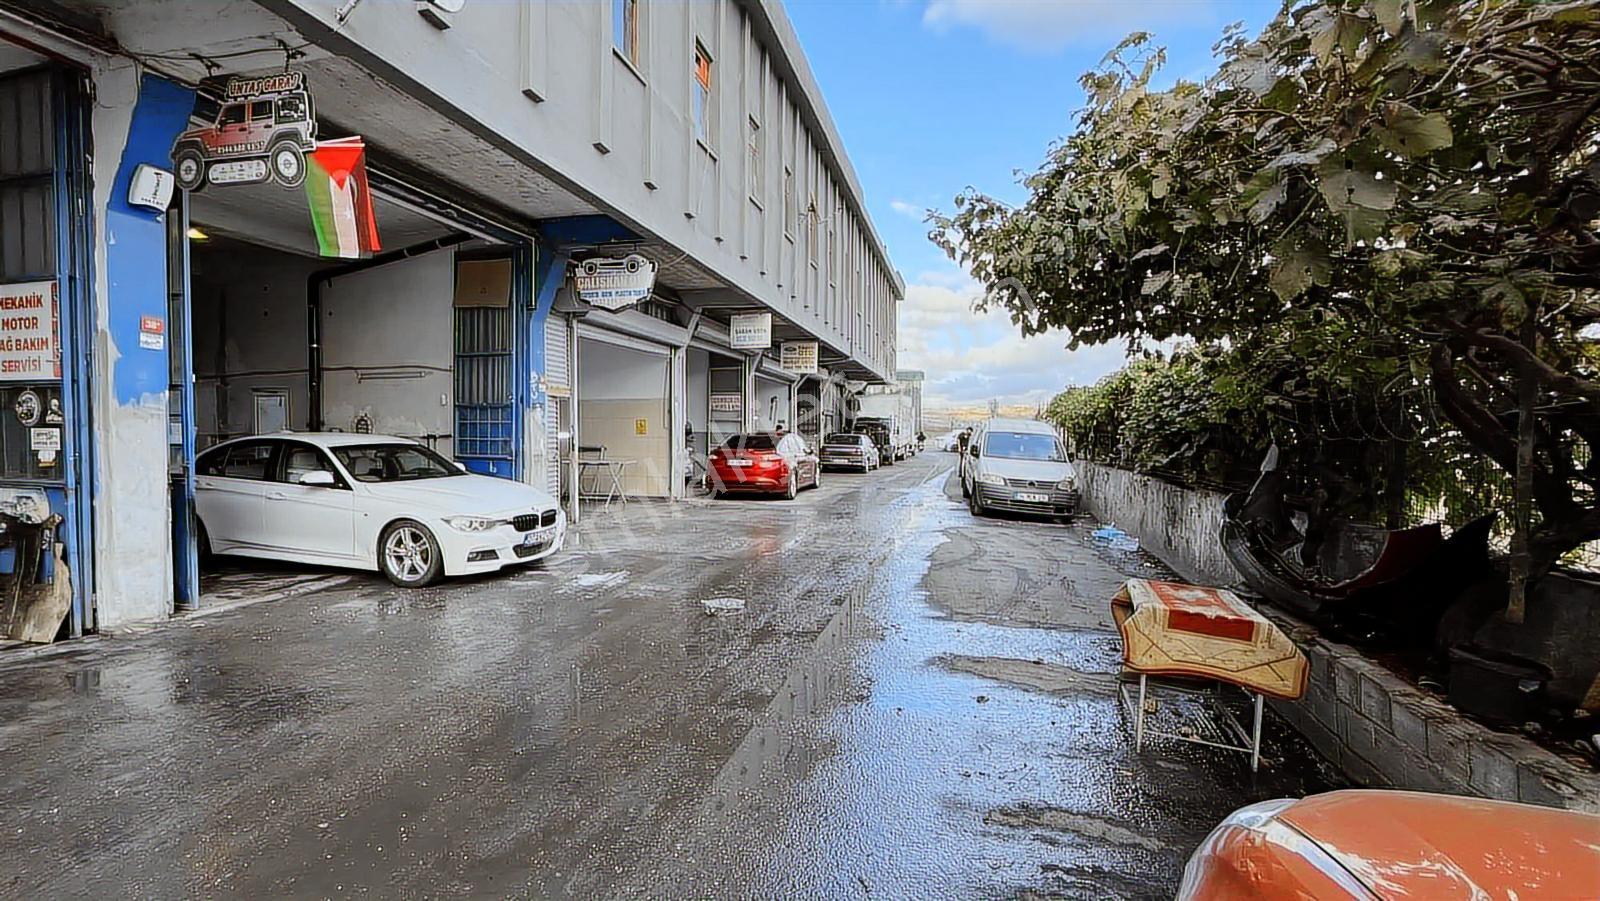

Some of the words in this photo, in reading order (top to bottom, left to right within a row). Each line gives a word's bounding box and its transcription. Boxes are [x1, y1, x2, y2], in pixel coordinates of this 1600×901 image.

[262, 73, 299, 92] GARAJ
[2, 317, 39, 331] MOTOR
[15, 338, 49, 351] BAKIM
[2, 356, 42, 373] SERVİSİ
